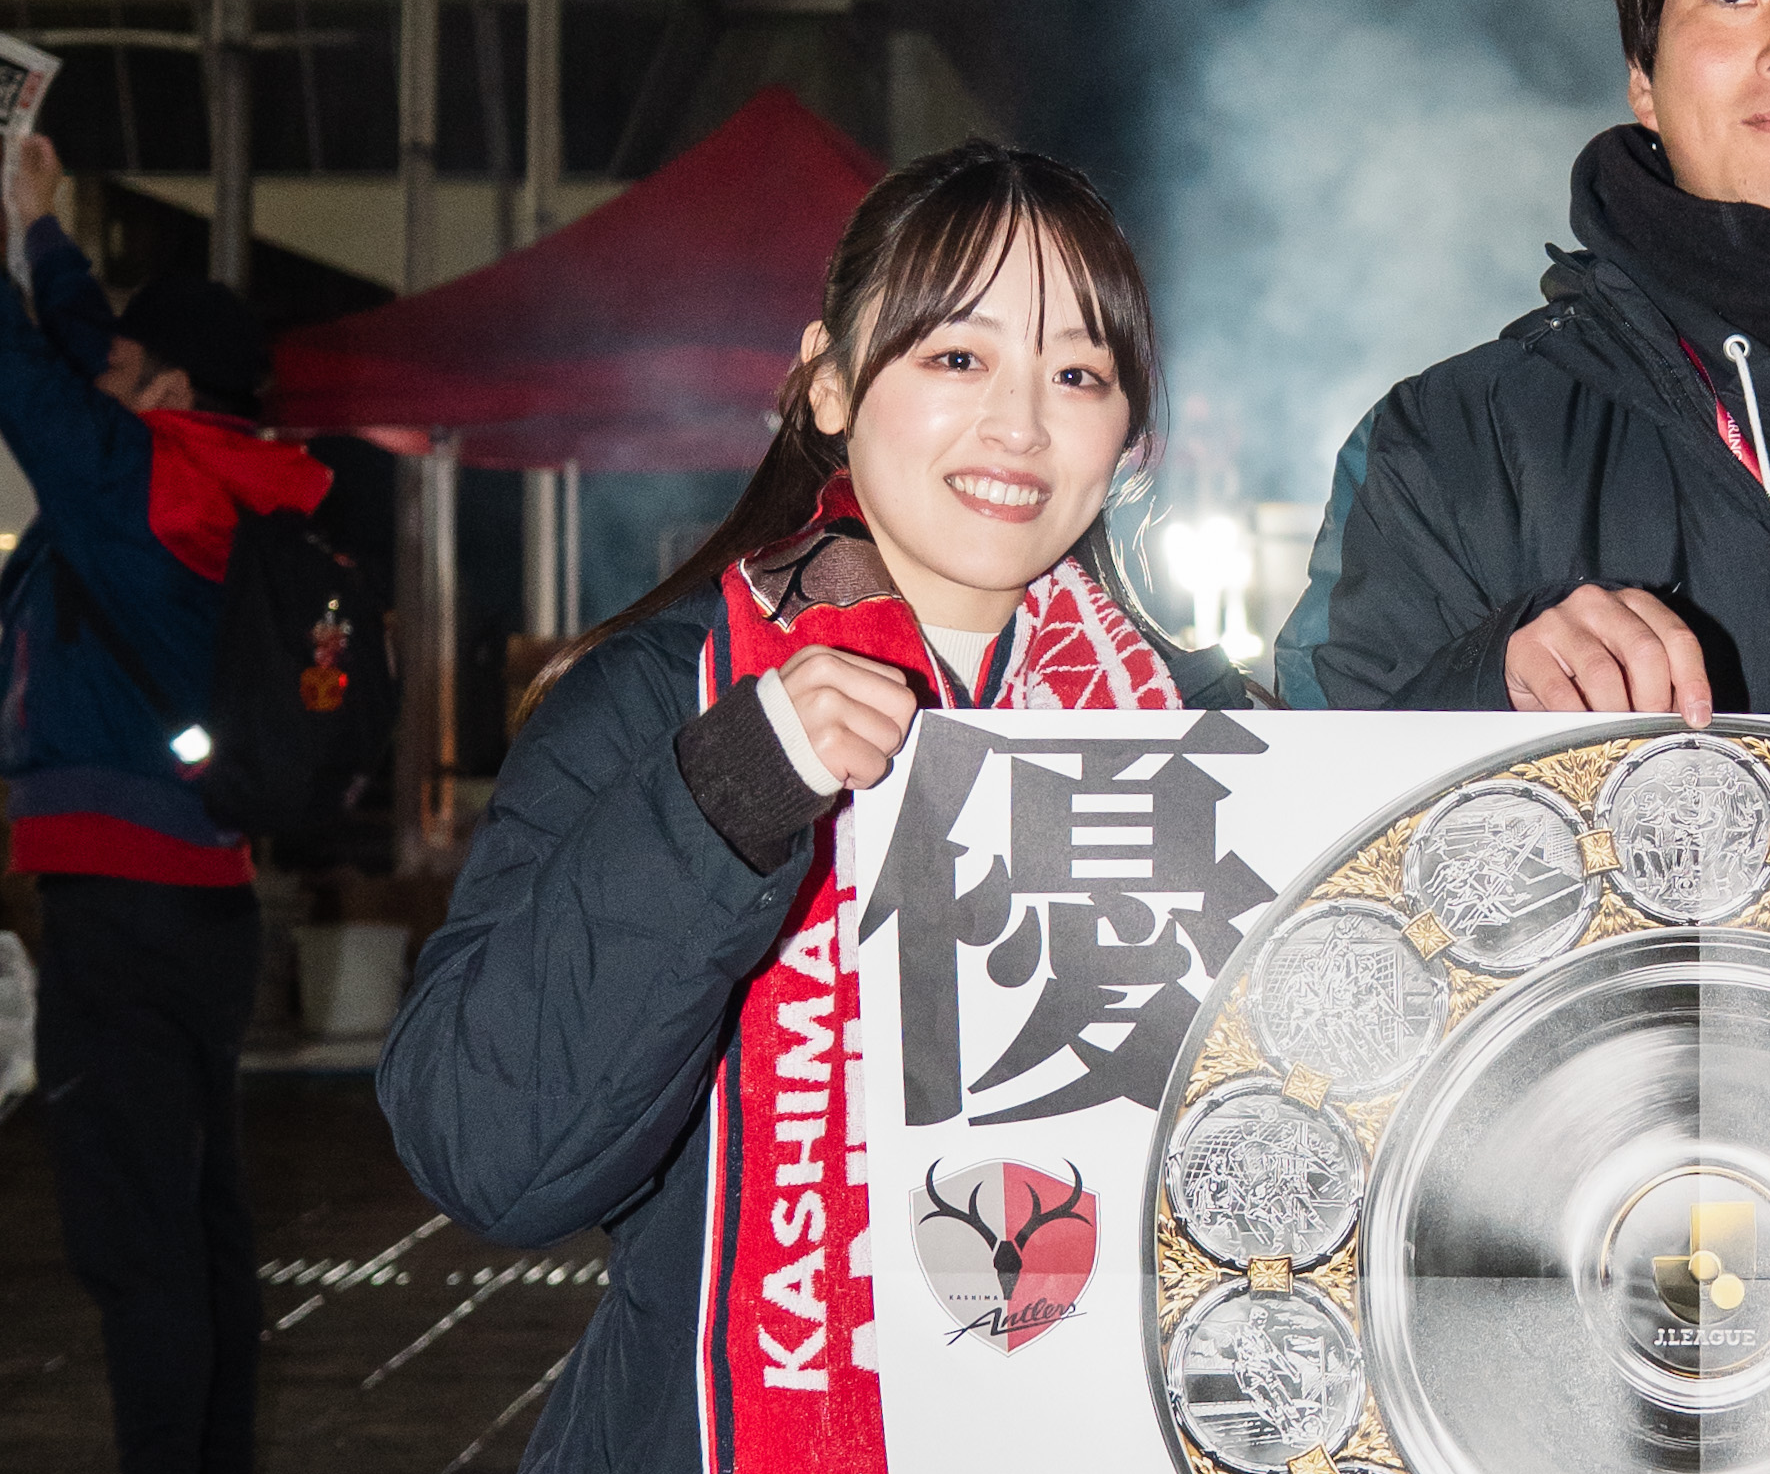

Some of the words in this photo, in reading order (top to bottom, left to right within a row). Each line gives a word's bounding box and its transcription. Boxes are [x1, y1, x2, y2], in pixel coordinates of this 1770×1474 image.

[858, 709, 1278, 1127] 優
[759, 915, 838, 1394] KASHIMA
[943, 1297, 1088, 1347] Antlers
[1653, 1327, 1757, 1346] J.LEAGUE
